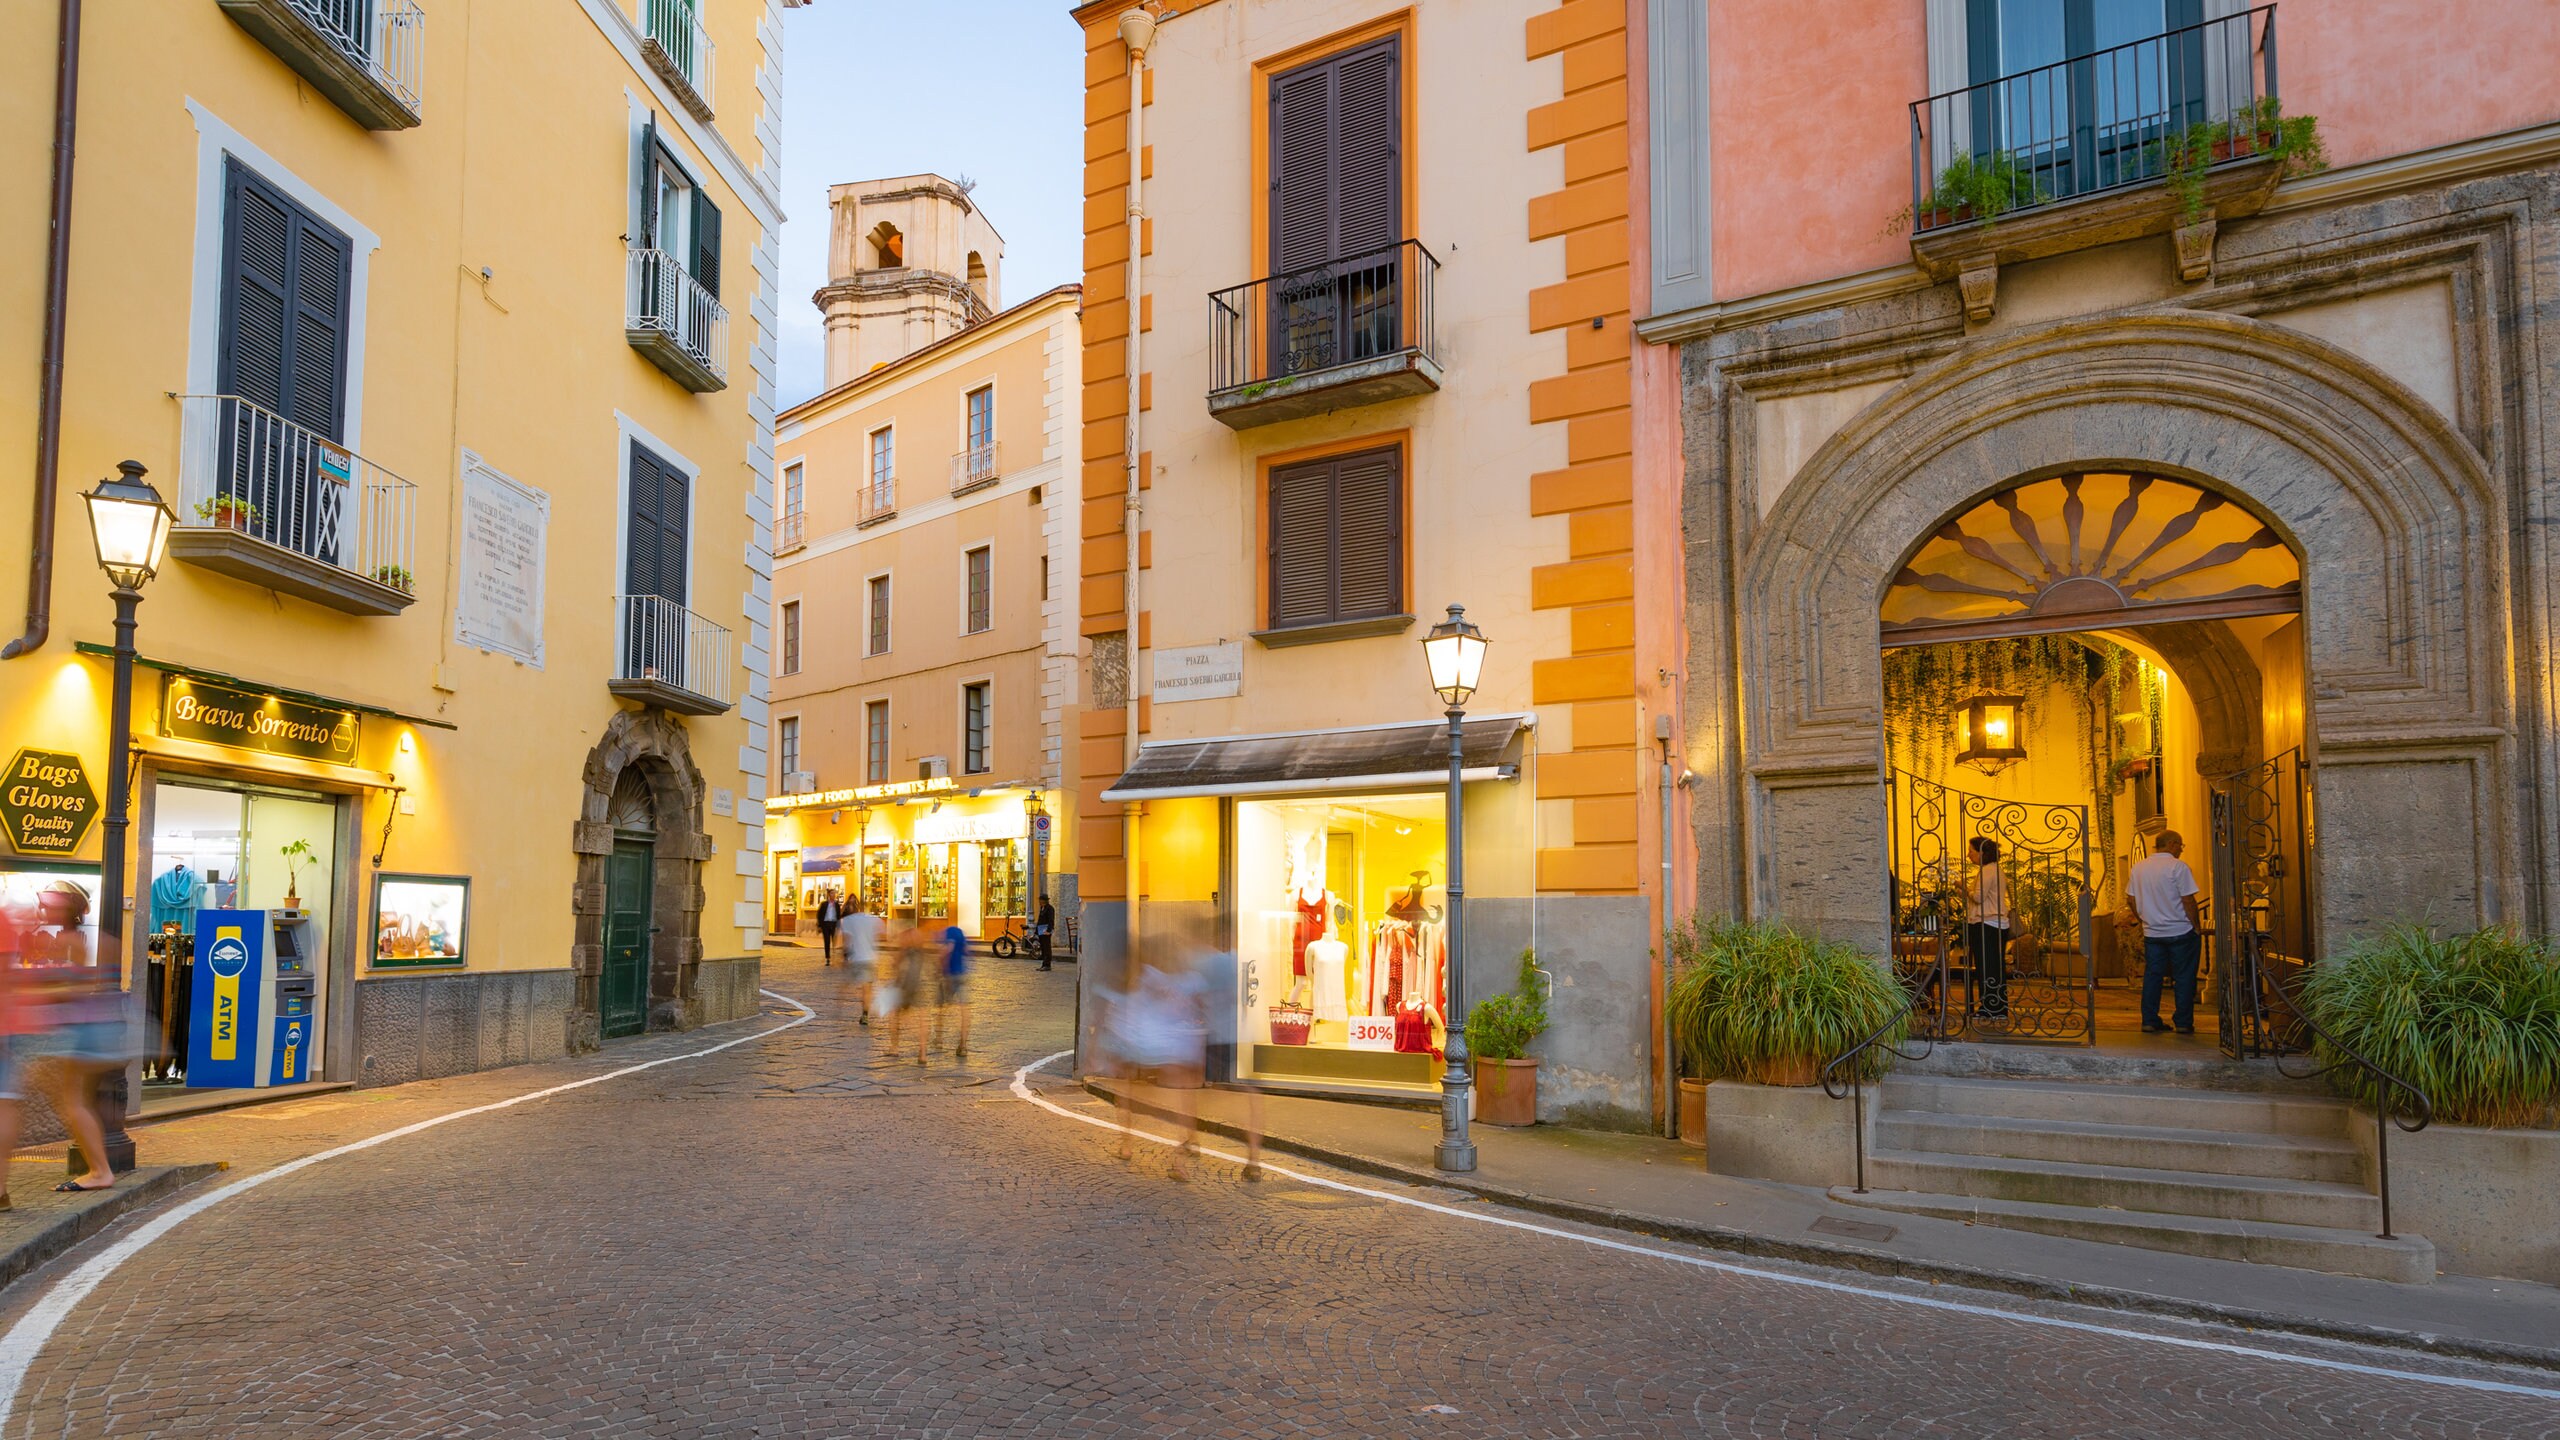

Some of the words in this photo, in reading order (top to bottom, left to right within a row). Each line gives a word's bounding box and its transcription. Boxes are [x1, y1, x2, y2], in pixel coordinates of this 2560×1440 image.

[324, 447, 349, 472] VENDESI
[1185, 655, 1209, 666] PIAZZA
[1154, 677, 1188, 689] FRANCESCO
[1189, 674, 1213, 686] SAVERIO
[175, 695, 245, 730] Brava
[247, 709, 329, 744] Sorrento
[19, 756, 80, 788] Bags
[8, 785, 86, 812] Gloves
[797, 793, 823, 806] SHOP
[825, 789, 854, 802] FOOD
[854, 785, 883, 799] WINE
[21, 813, 74, 834] Quality
[21, 831, 73, 847] Leather
[218, 995, 232, 1040] ATM
[1350, 1025, 1393, 1040] -30%
